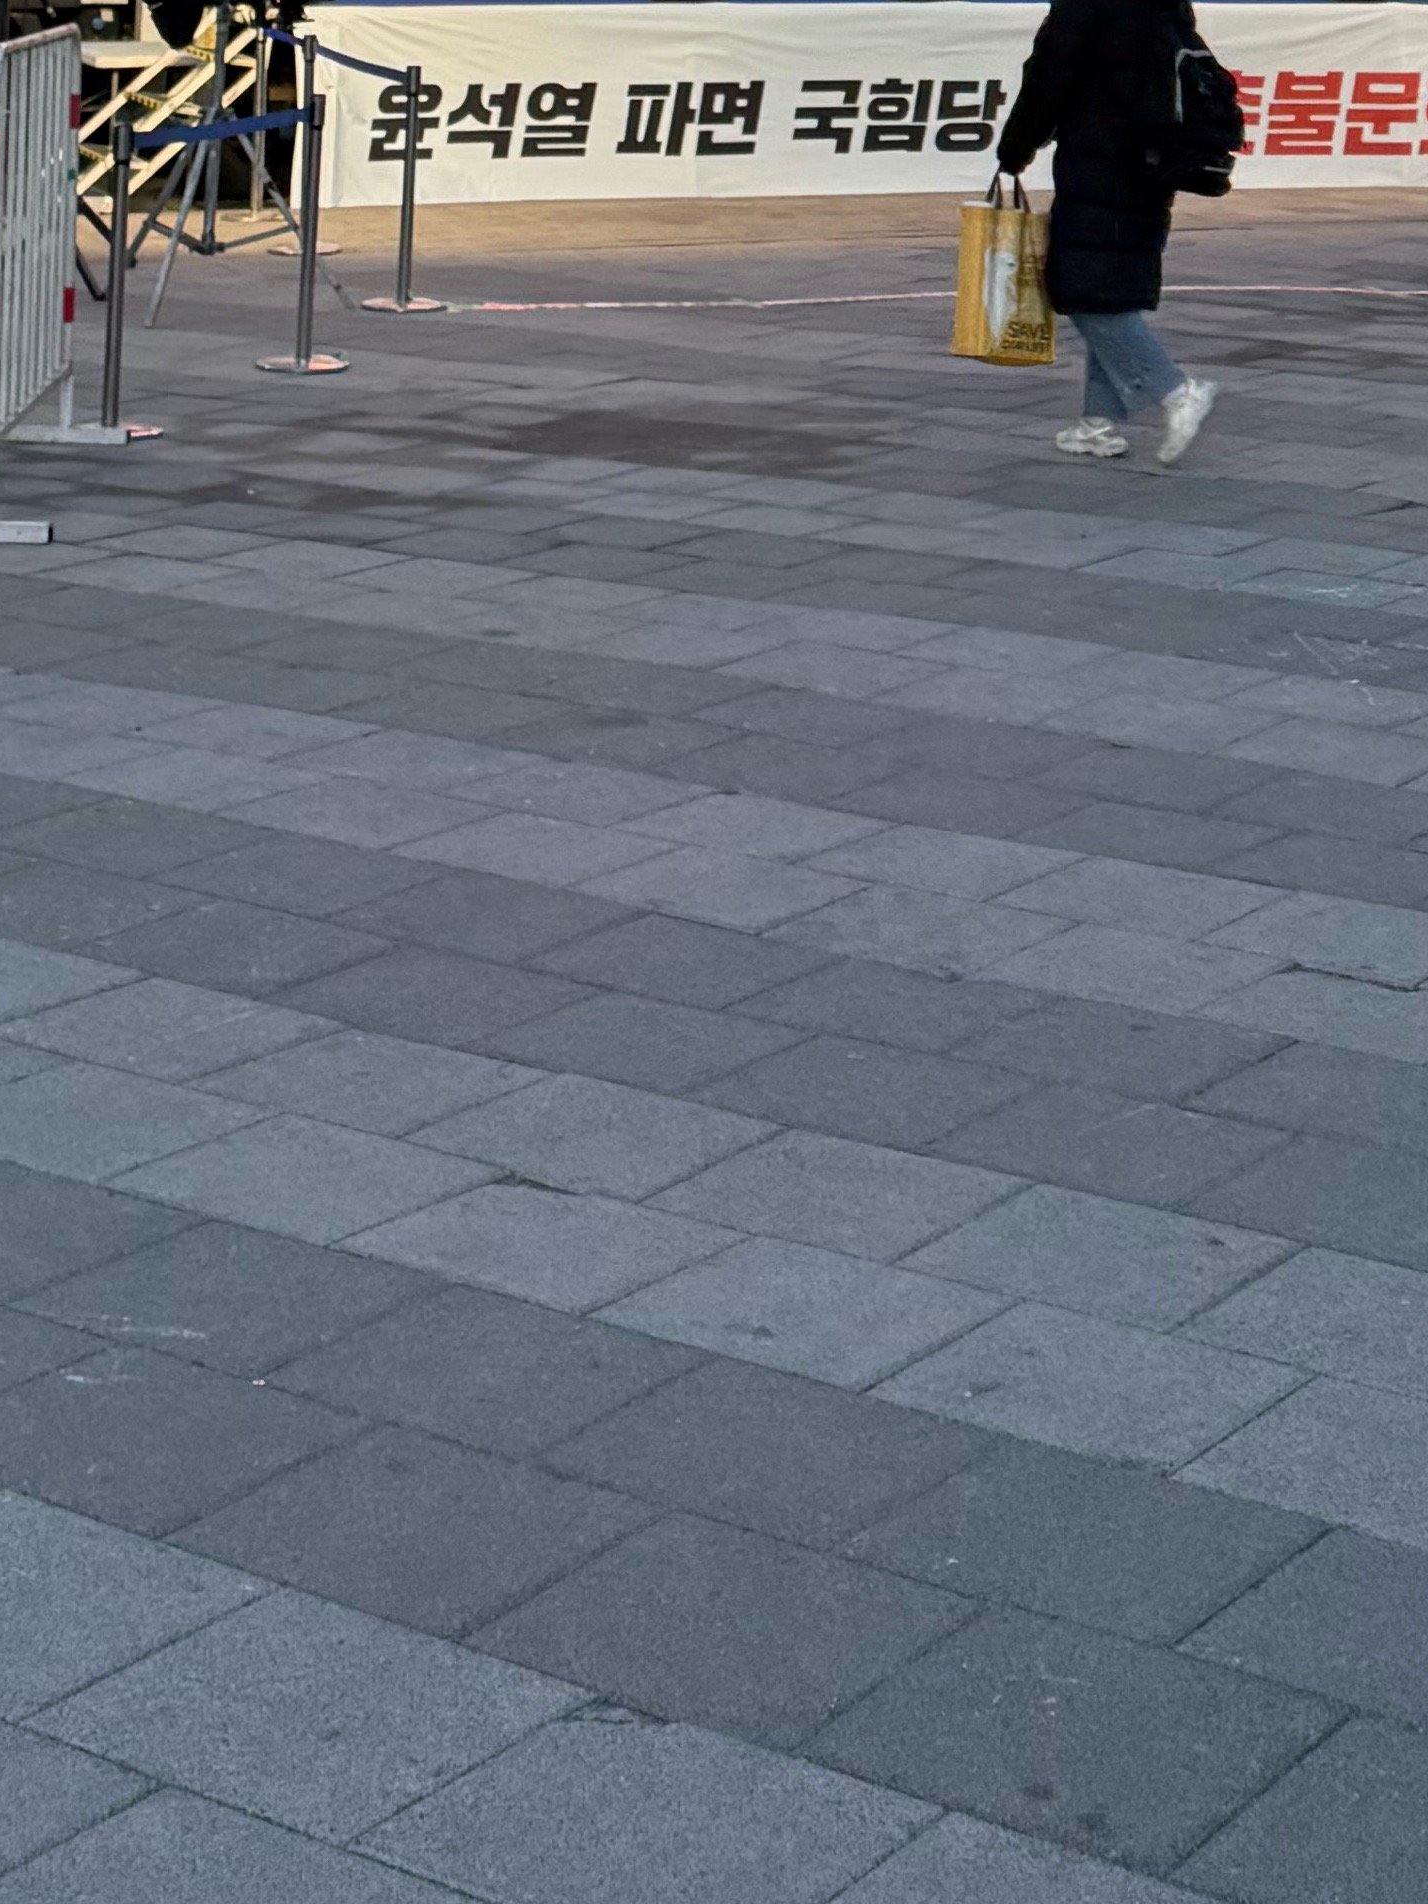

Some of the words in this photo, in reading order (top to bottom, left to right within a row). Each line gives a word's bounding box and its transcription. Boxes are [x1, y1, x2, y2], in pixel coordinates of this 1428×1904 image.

[368, 82, 597, 162] 윤석열
[615, 80, 766, 156] 파면
[791, 78, 1007, 155] 국힘당
